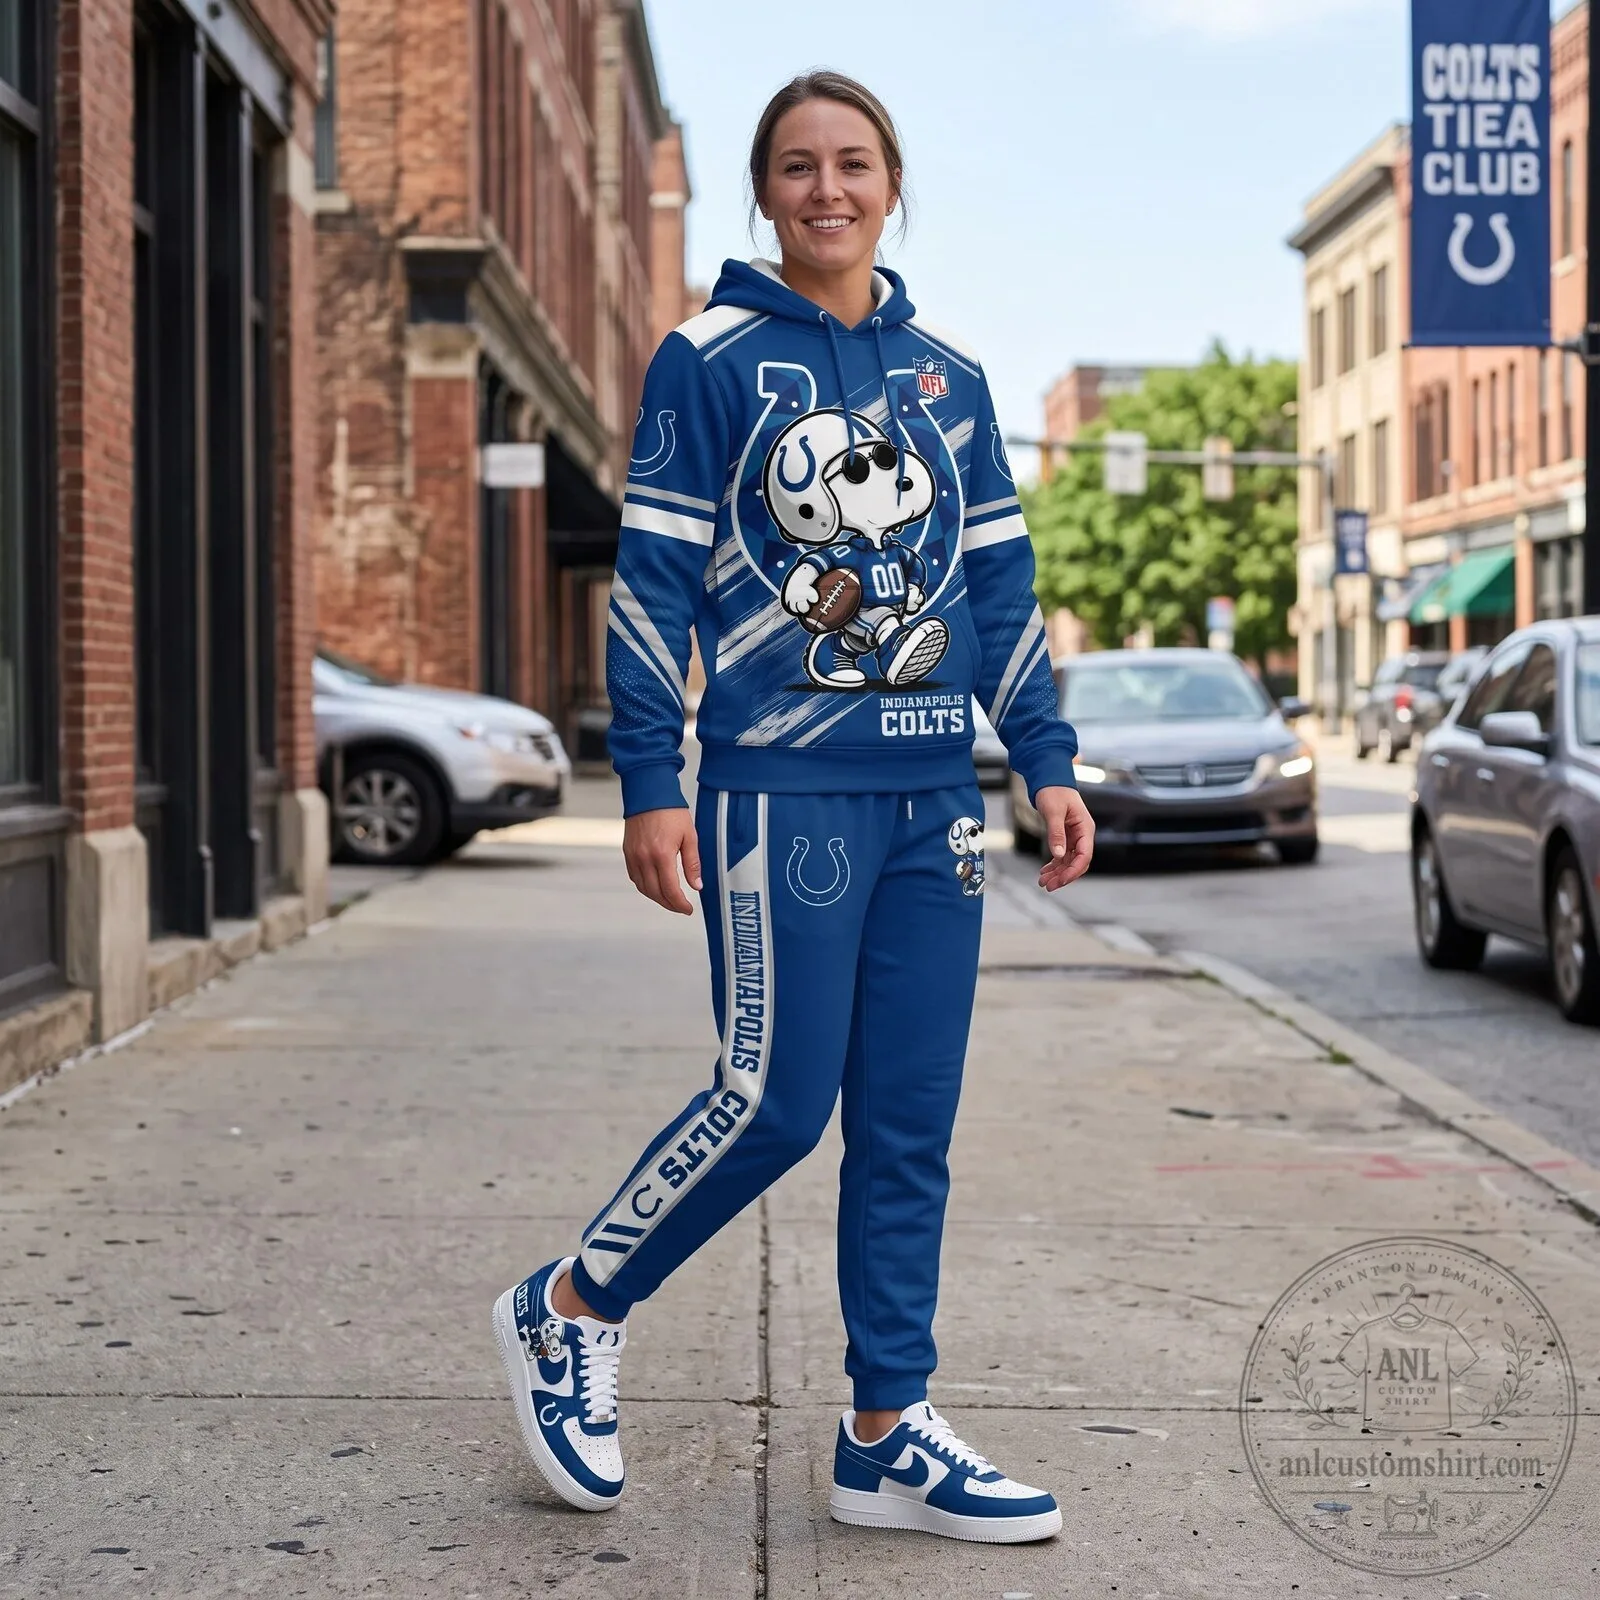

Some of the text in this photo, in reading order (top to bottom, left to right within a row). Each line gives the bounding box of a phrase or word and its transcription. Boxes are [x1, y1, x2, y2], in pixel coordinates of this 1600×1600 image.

[1422, 43, 1541, 101] COLTS
[1423, 103, 1540, 149] TIEA
[1422, 152, 1541, 195] CLUB
[919, 374, 946, 396] NFL
[871, 562, 905, 598] 00
[880, 694, 964, 709] INDIANAPOLIS
[881, 708, 965, 737] COLTS
[657, 1089, 749, 1190] COLTS
